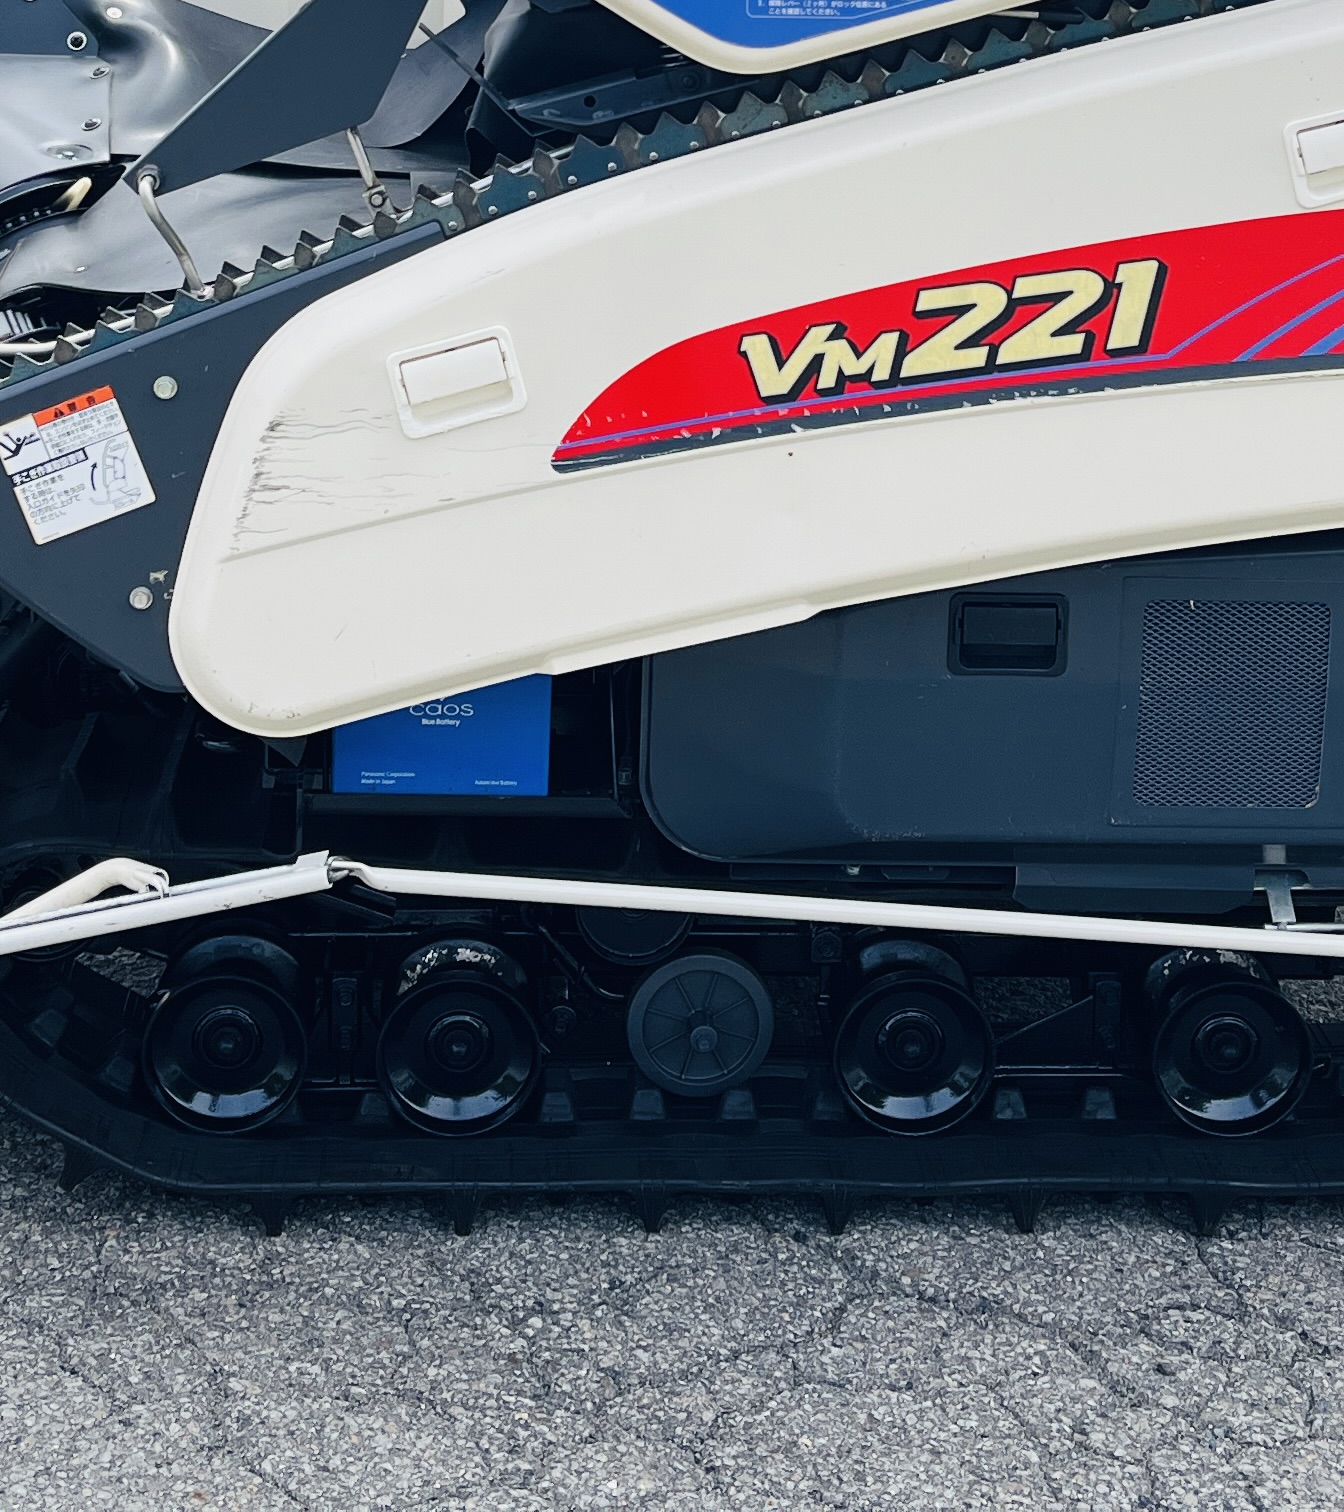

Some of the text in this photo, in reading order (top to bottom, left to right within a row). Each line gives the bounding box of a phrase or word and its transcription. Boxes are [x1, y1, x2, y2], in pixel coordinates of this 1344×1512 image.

[741, 258, 1168, 403] VM221
[409, 703, 474, 717] caos
[421, 717, 461, 727] Blue Battery
